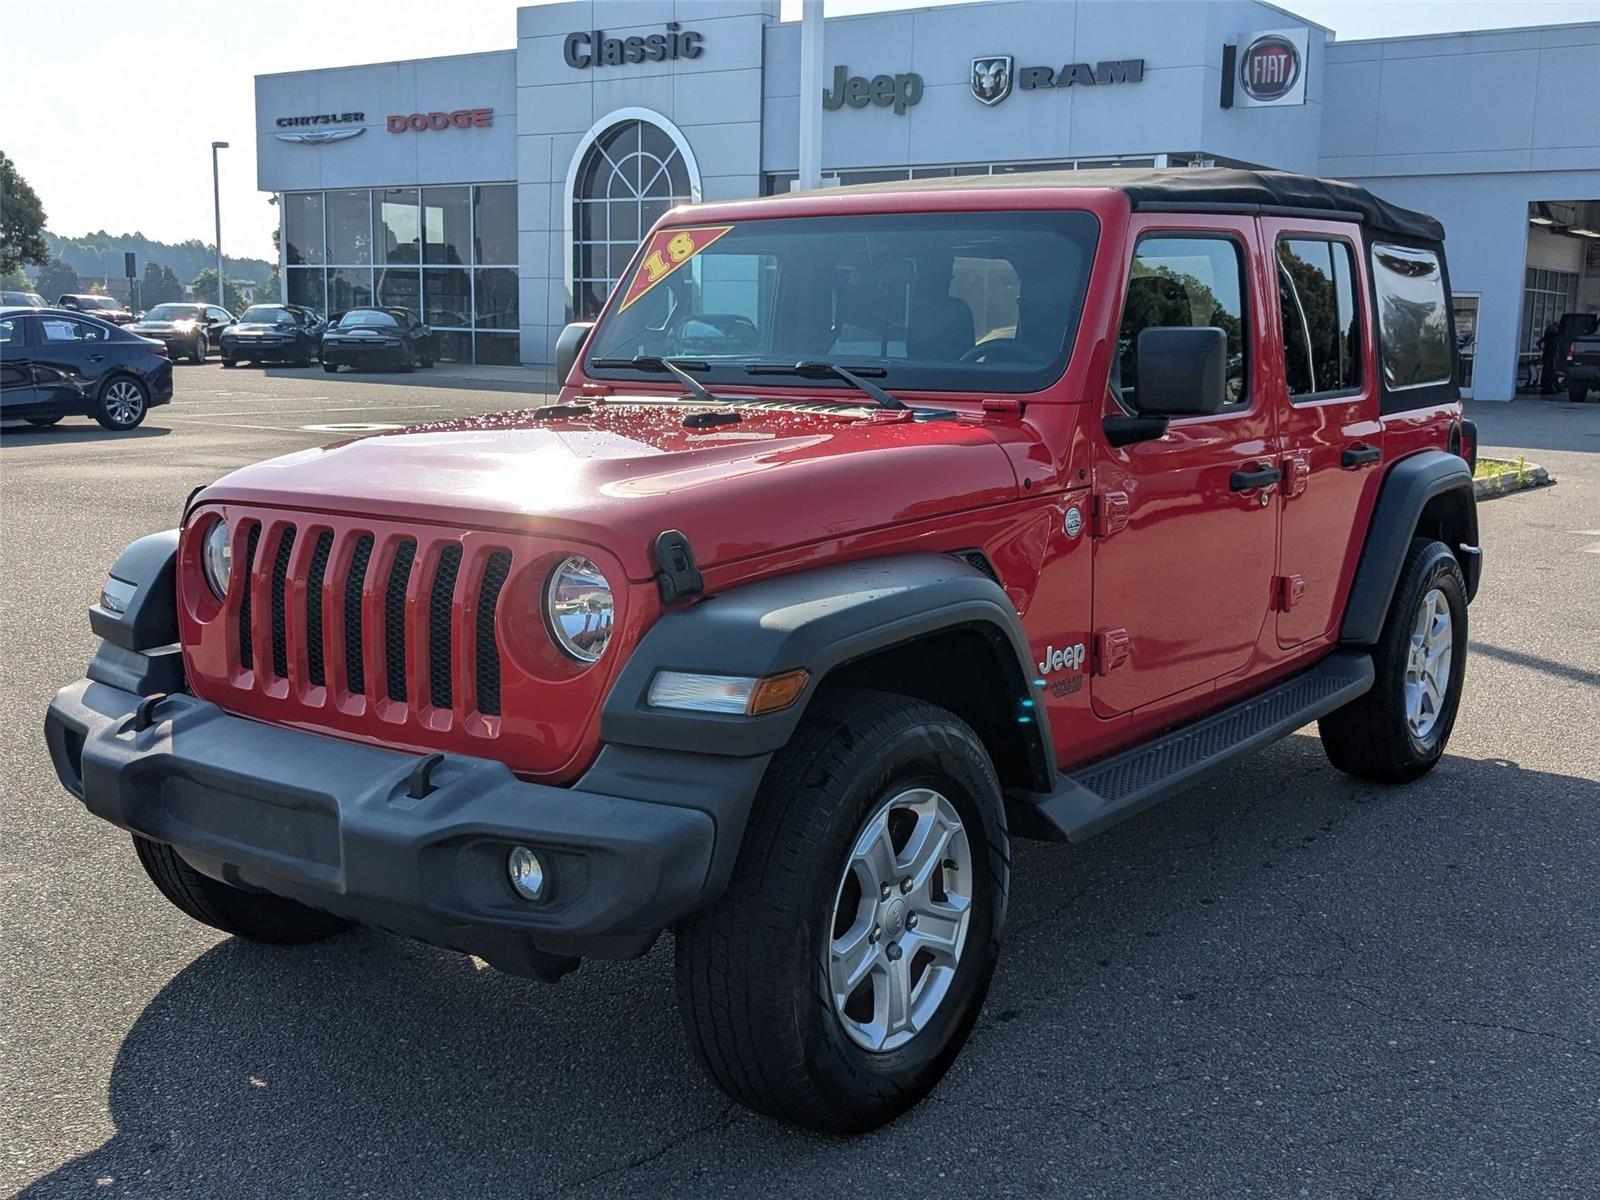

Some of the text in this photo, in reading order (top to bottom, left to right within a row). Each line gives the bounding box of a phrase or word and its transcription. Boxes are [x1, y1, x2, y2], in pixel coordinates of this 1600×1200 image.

[564, 22, 704, 69] Classic
[1019, 58, 1144, 91] RAM
[1253, 54, 1288, 84] FIAT
[822, 65, 924, 116] Jeep
[275, 112, 365, 128] CHRYSLER
[387, 107, 494, 133] DODGE
[644, 231, 695, 282] 18
[1038, 642, 1086, 676] Jeep
